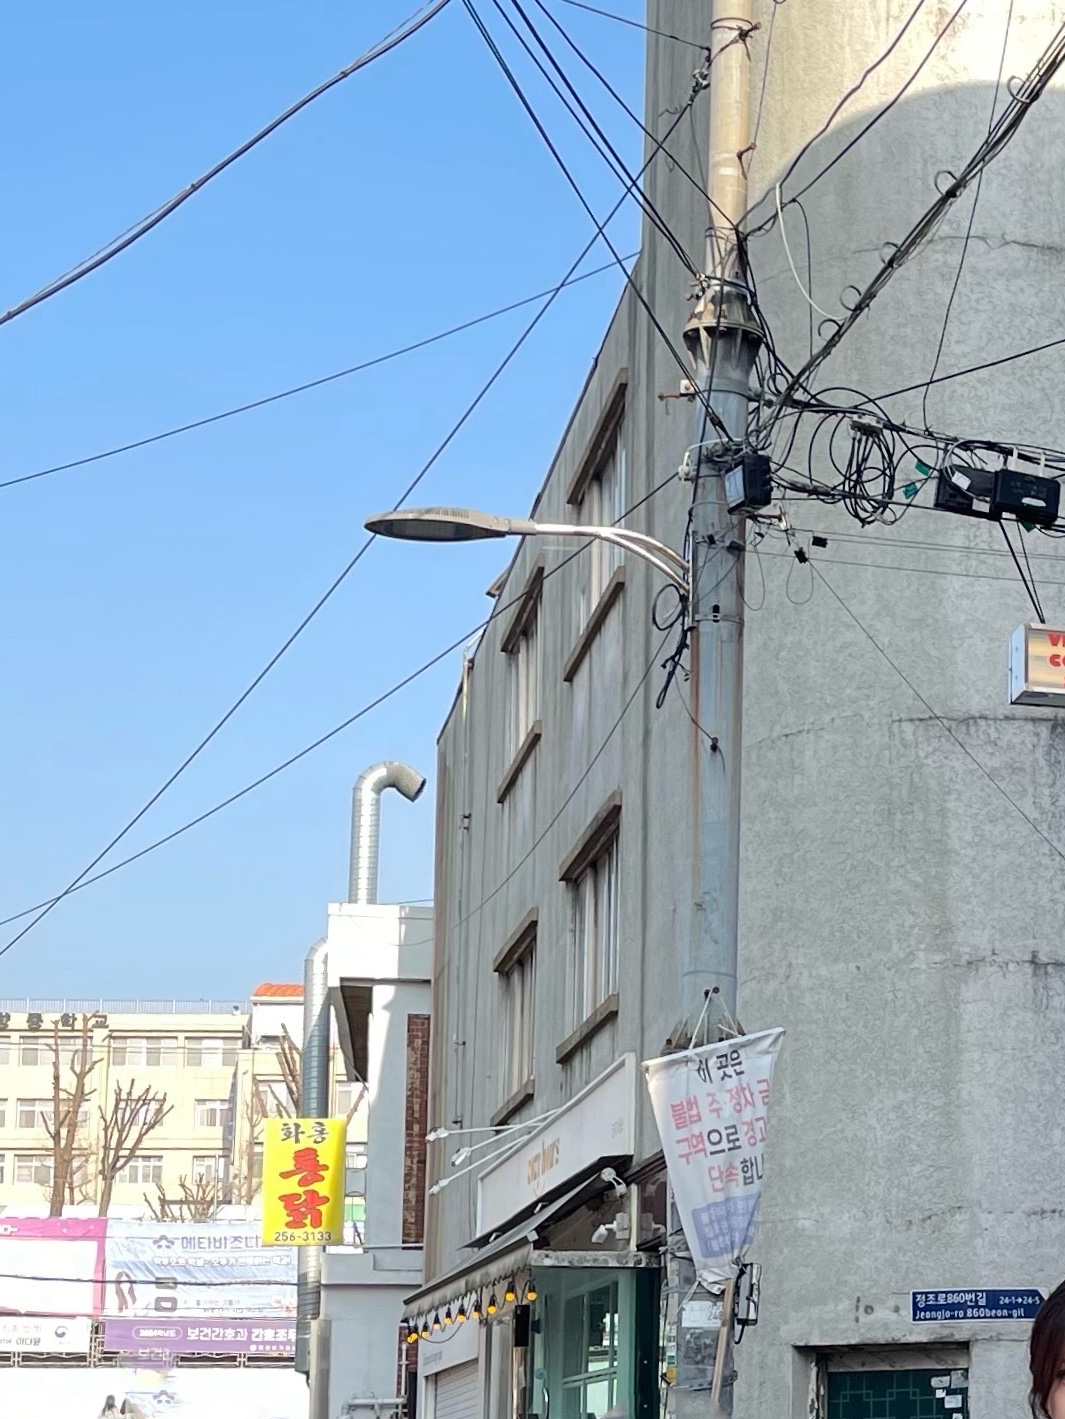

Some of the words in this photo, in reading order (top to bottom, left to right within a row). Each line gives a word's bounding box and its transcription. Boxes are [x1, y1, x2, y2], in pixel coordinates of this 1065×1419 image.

[698, 1058, 713, 1084] 이
[716, 1050, 745, 1081] 곳은
[670, 1095, 702, 1130] 불법
[281, 1121, 329, 1144] 화홍
[676, 1125, 742, 1165] 구역으로
[274, 1231, 332, 1242] 256-3133
[915, 1292, 987, 1308] 정조로860번길
[915, 1309, 964, 1320] Jeongjo-ro
[966, 1307, 1025, 1319] 860beon-gil
